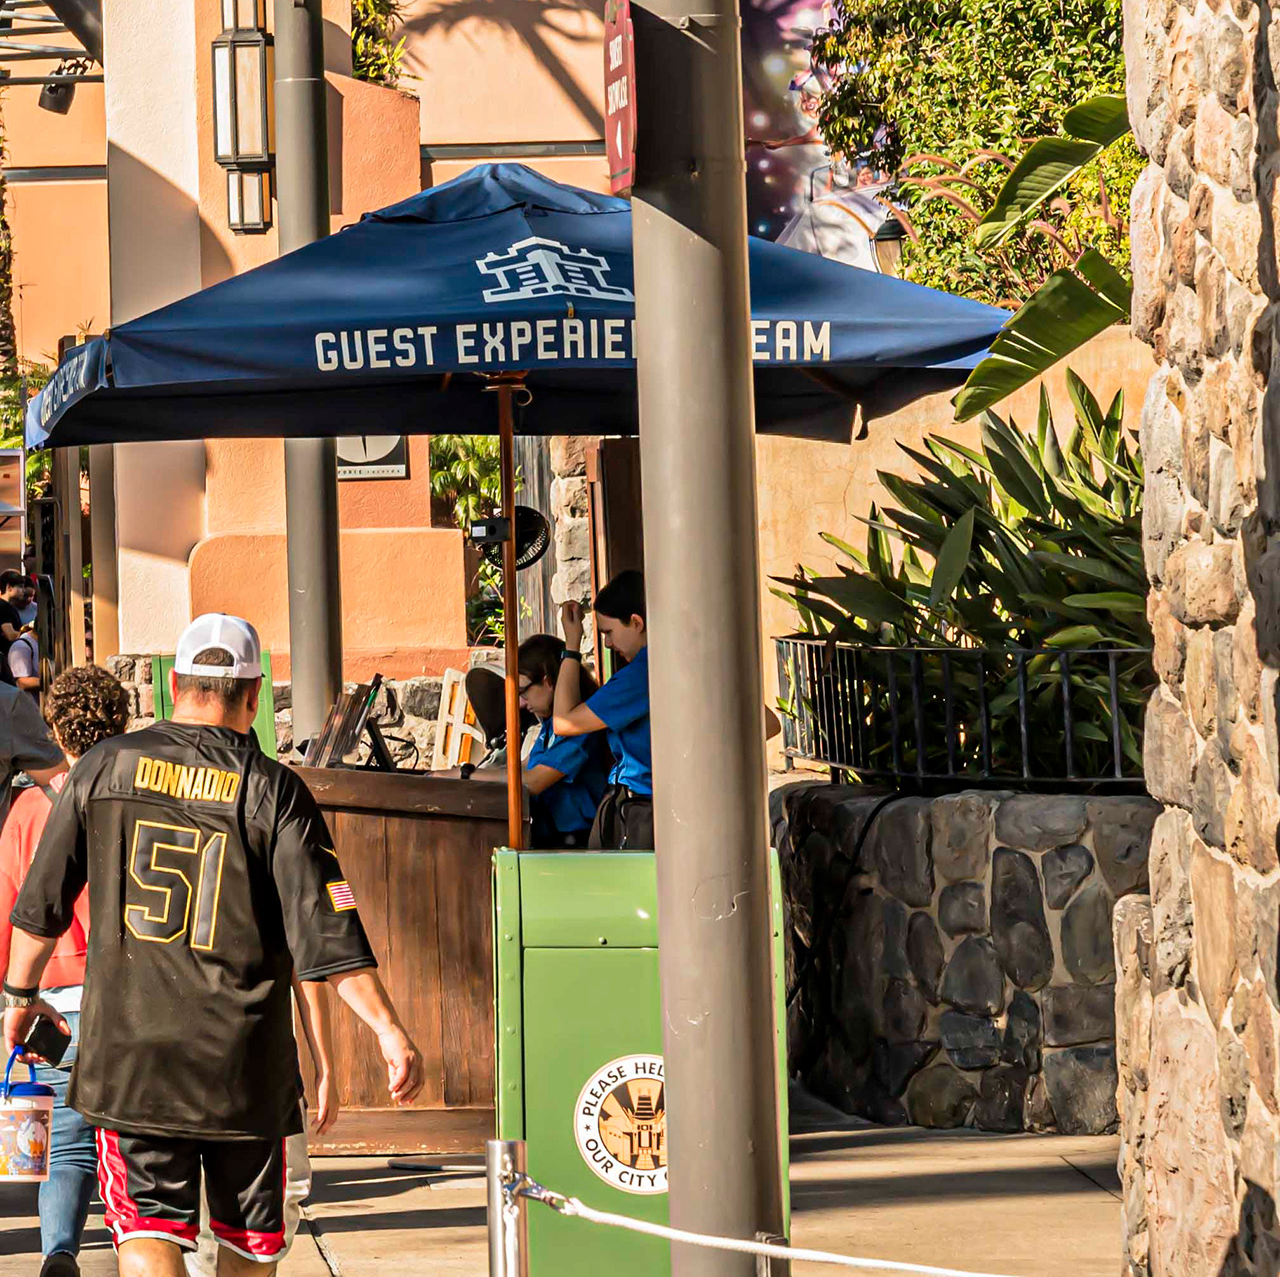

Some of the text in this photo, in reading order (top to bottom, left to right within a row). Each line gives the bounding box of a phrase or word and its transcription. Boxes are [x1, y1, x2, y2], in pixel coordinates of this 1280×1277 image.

[315, 318, 831, 372] GUEST EXPERIE EAM
[134, 756, 240, 804] DONNADIO
[124, 819, 228, 951] 51
[582, 1062, 665, 1117] PLEASE HEL
[585, 1138, 657, 1187] OUR CITY
